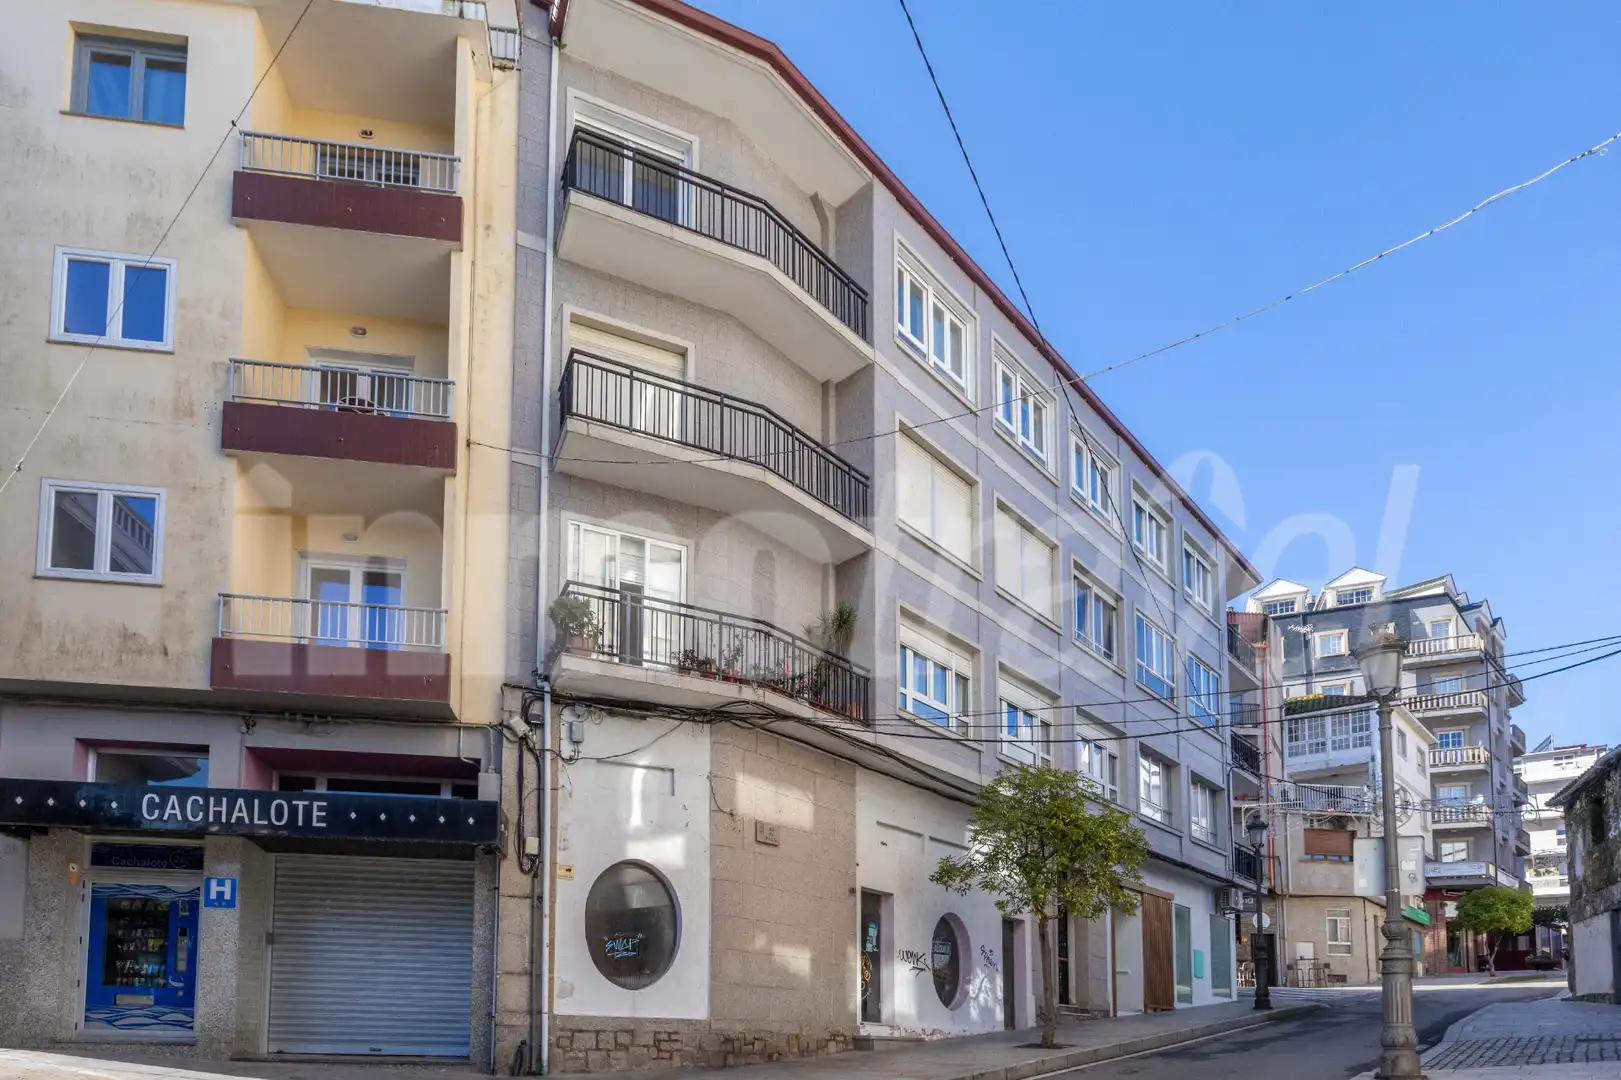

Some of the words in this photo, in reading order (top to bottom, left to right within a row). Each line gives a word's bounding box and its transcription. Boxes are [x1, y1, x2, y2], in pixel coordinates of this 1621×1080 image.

[141, 793, 328, 828] CACHALOTE
[111, 856, 169, 868] Cachalote
[209, 879, 232, 900] H
